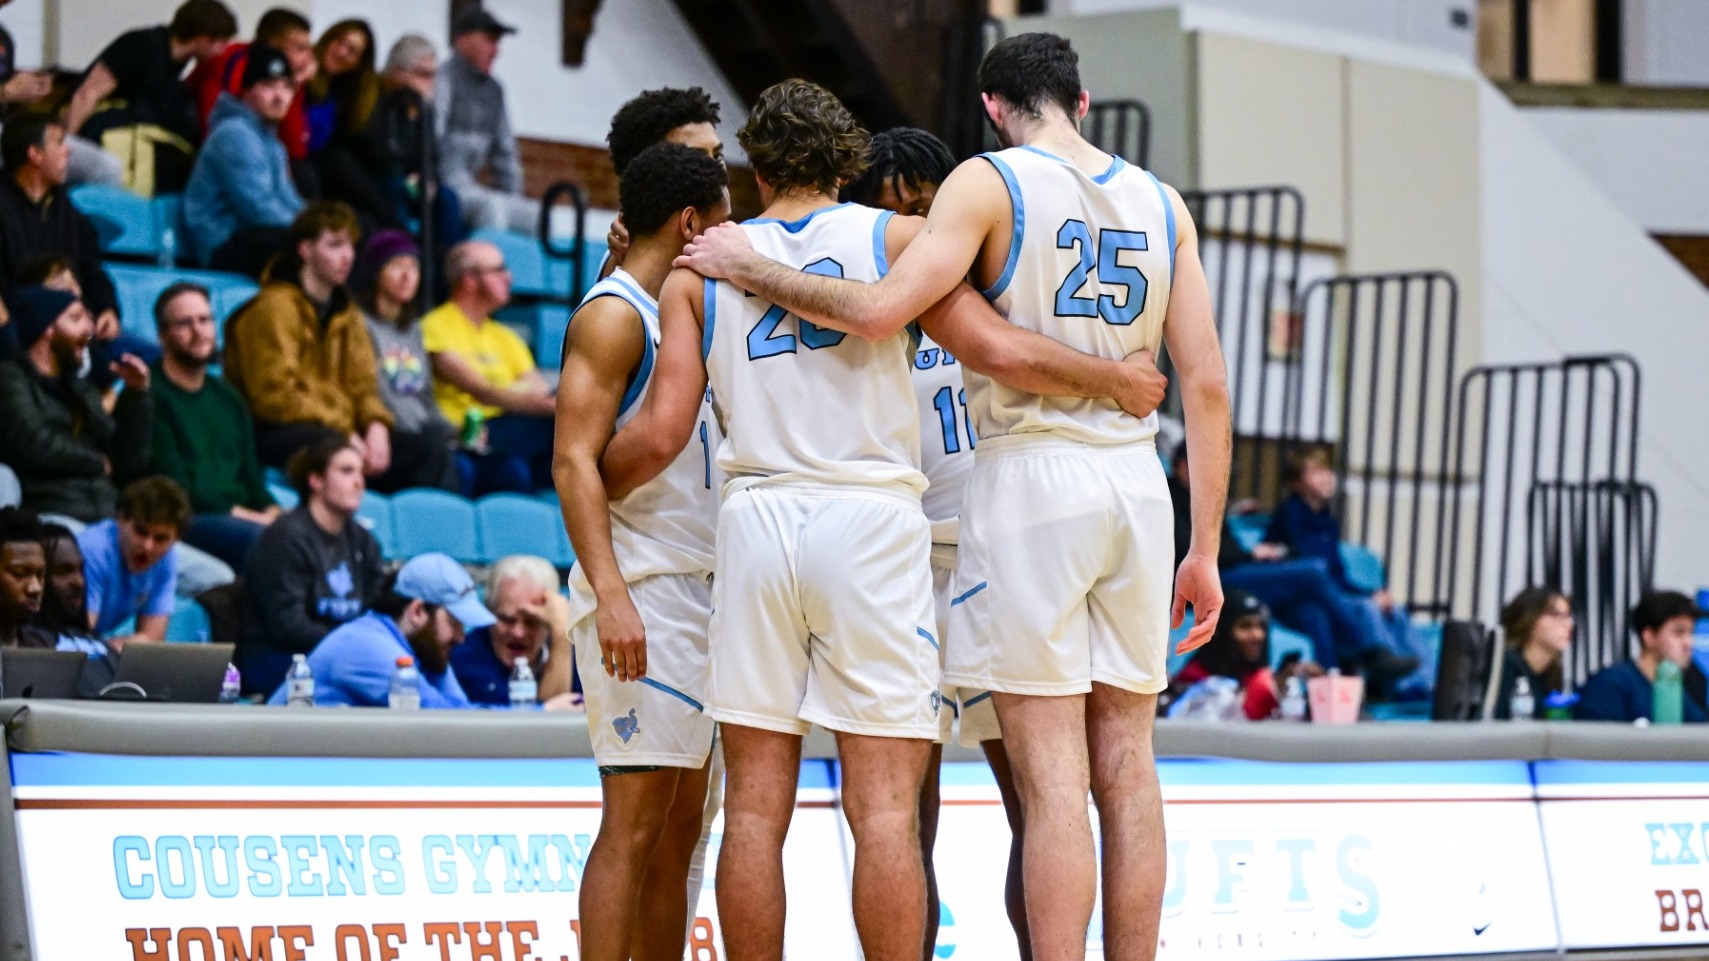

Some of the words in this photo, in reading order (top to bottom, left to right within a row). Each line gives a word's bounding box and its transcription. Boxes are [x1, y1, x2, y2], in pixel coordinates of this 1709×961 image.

[1054, 218, 1149, 326] 25
[113, 835, 405, 899] COUSENS
[125, 925, 315, 961] HOME
[335, 922, 408, 961] OF
[423, 920, 540, 961] THE
